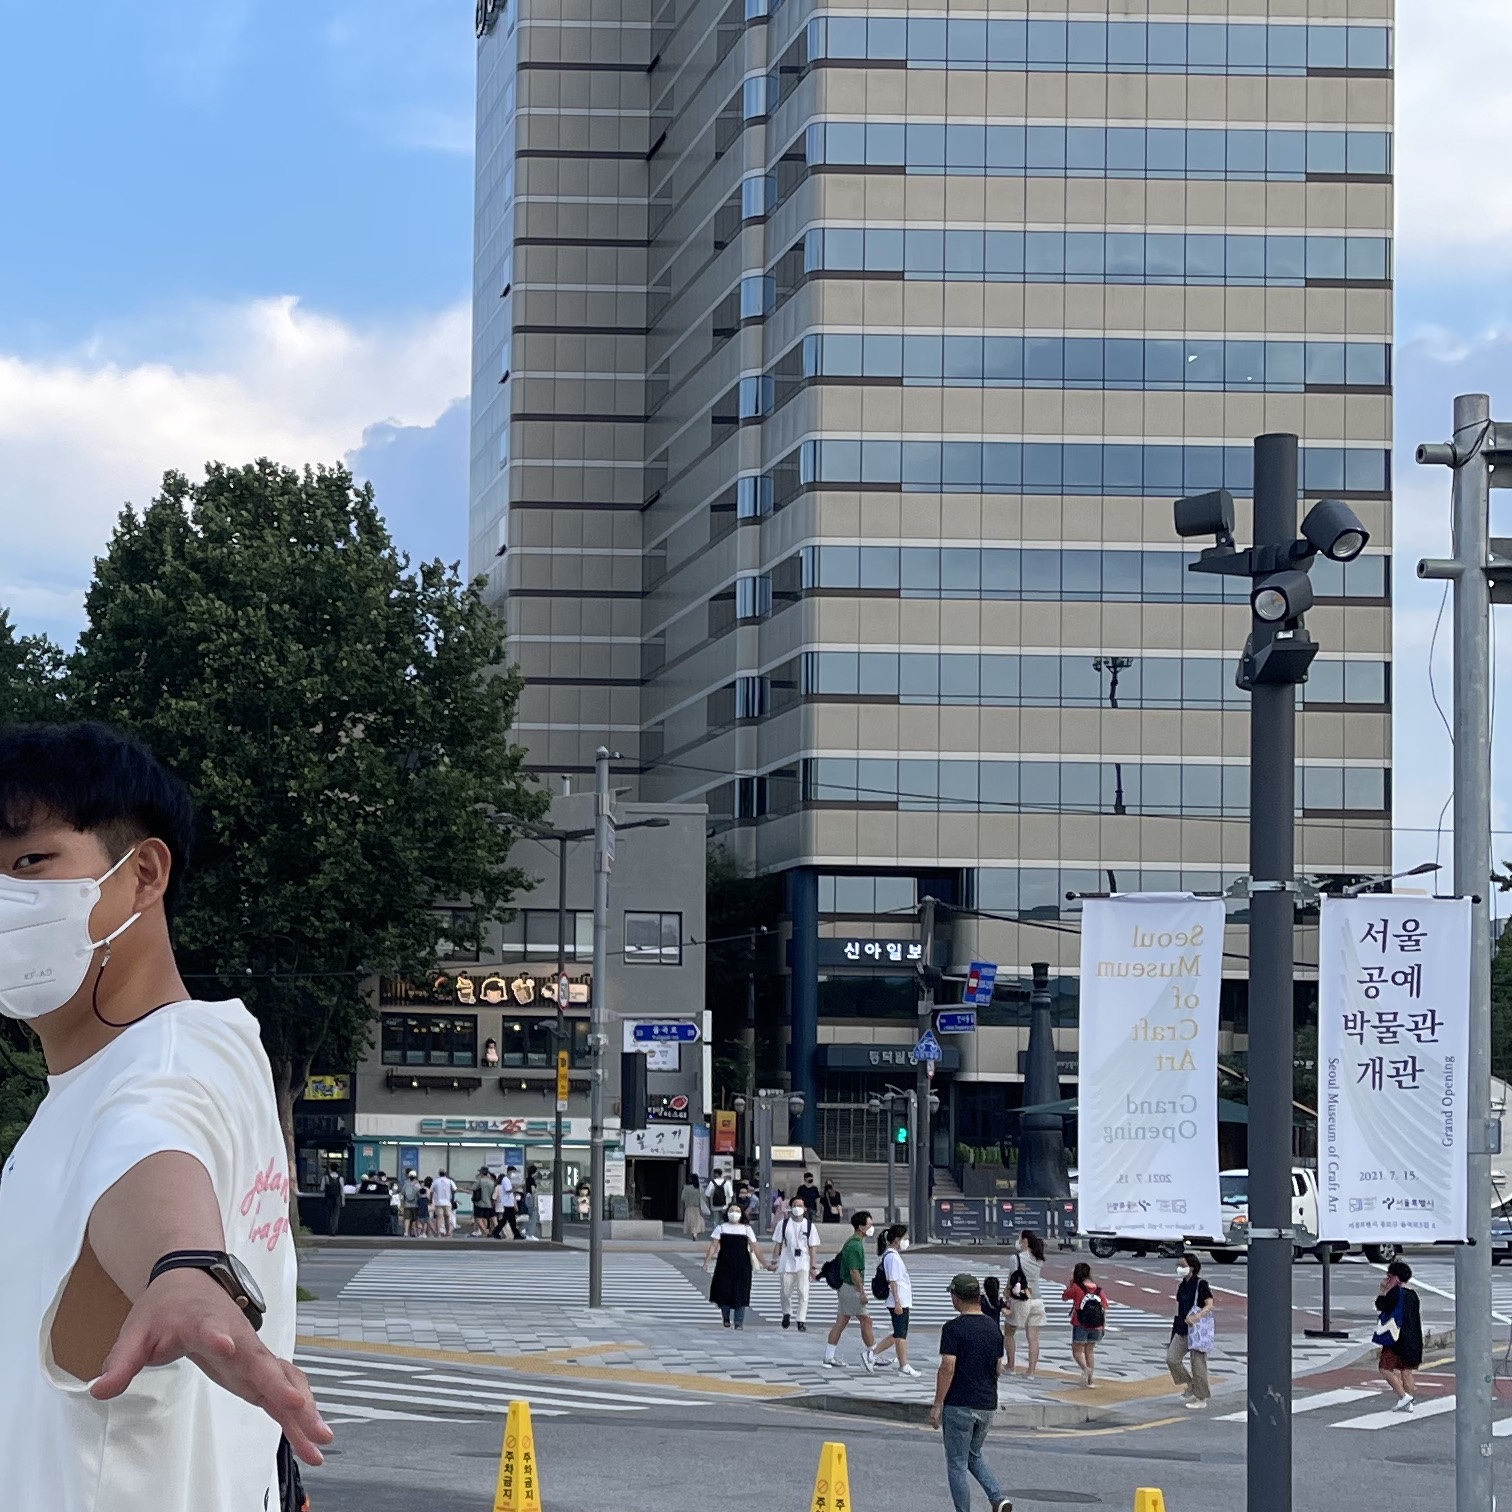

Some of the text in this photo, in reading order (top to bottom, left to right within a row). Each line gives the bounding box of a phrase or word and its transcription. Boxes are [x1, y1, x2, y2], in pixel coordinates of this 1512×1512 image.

[844, 942, 922, 961] 신아일보
[1360, 918, 1428, 953] 서울
[1357, 964, 1422, 999] 공예
[1342, 1009, 1444, 1045] 박물관
[1357, 1055, 1425, 1091] 개관
[1441, 1055, 1456, 1147] Grand Opening
[1328, 1058, 1340, 1213] Seoul Museum of Craft Art
[503, 1451, 515, 1500] 주차금지
[522, 1452, 534, 1501] 주차금지
